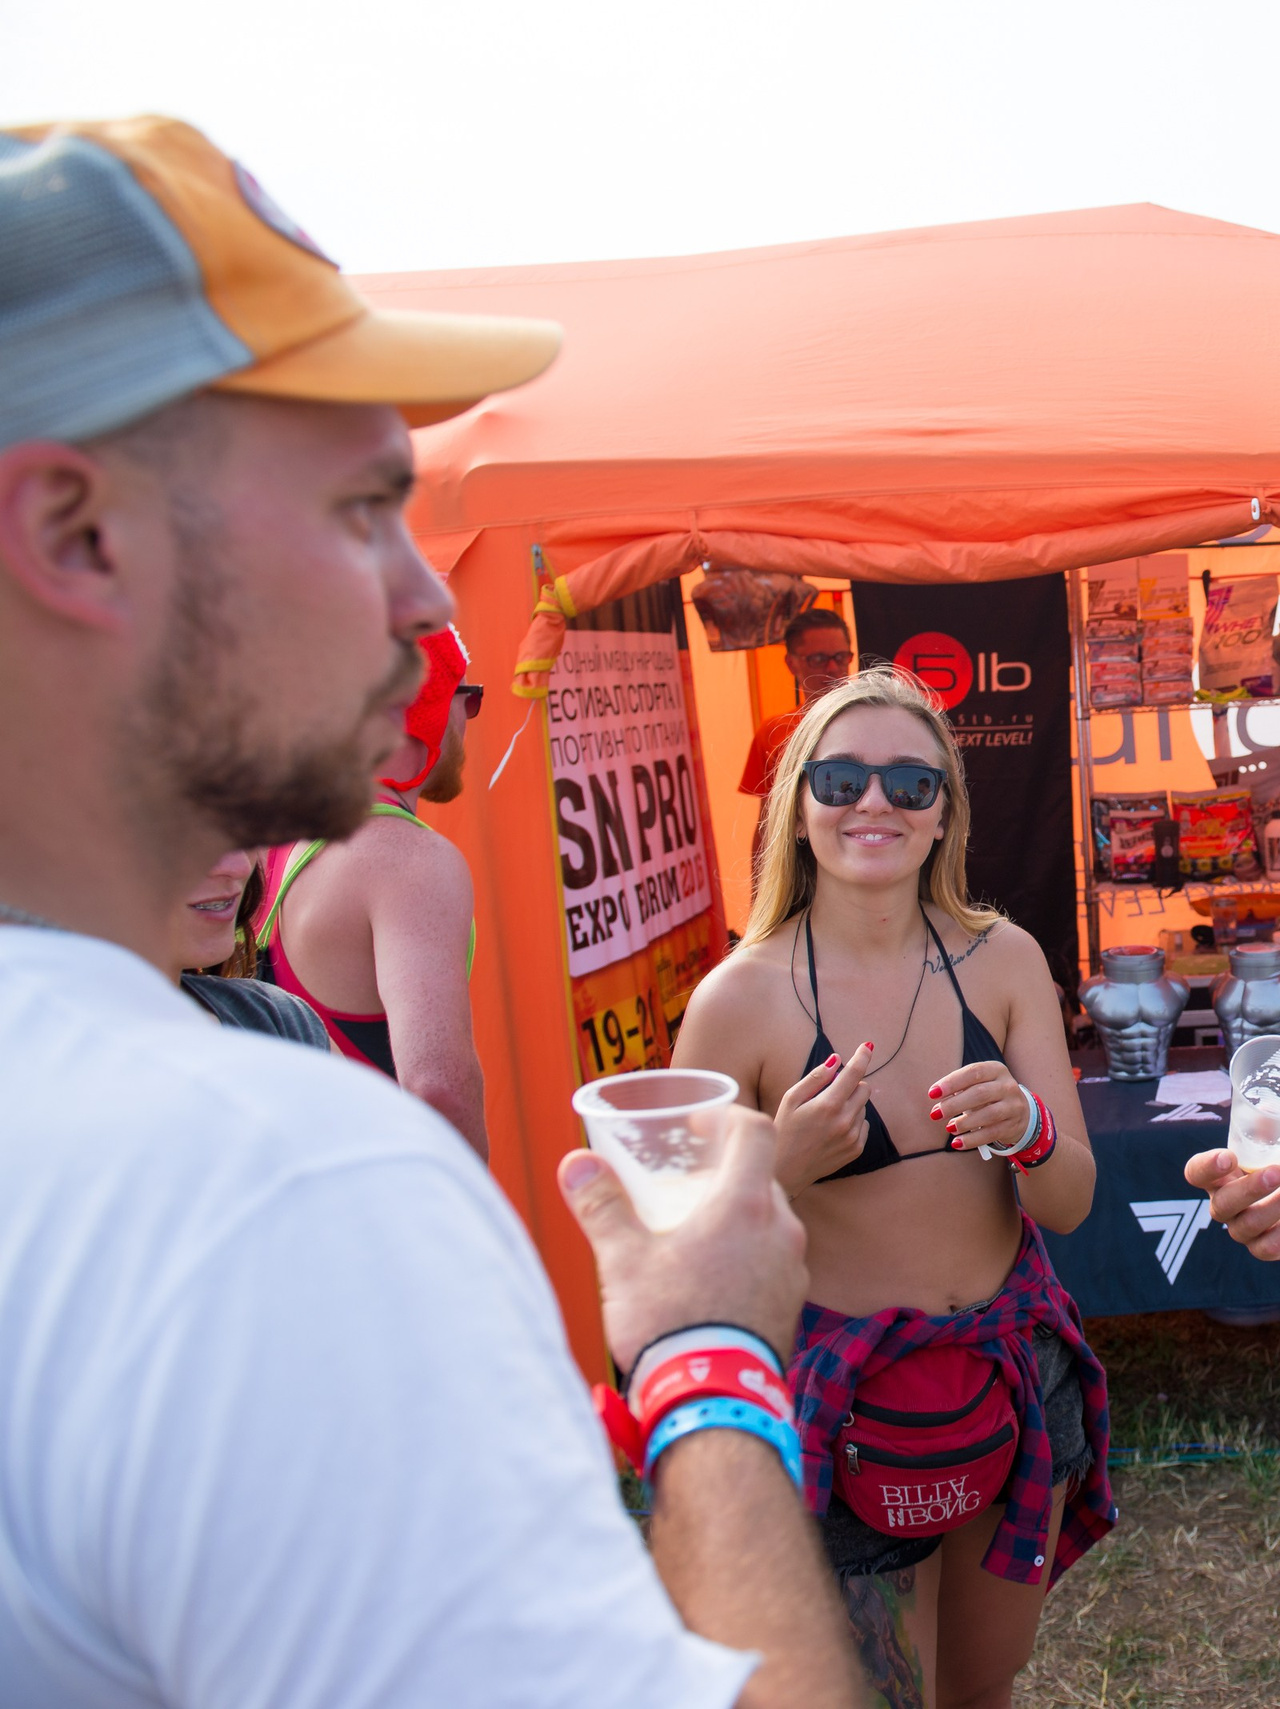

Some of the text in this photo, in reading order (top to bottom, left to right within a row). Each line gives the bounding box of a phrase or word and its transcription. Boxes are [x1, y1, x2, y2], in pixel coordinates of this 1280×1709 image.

[911, 652, 1032, 693] 5lb
[986, 731, 1034, 748] LEVEL!
[554, 753, 697, 890] SN PRO
[565, 889, 632, 952] EXPO
